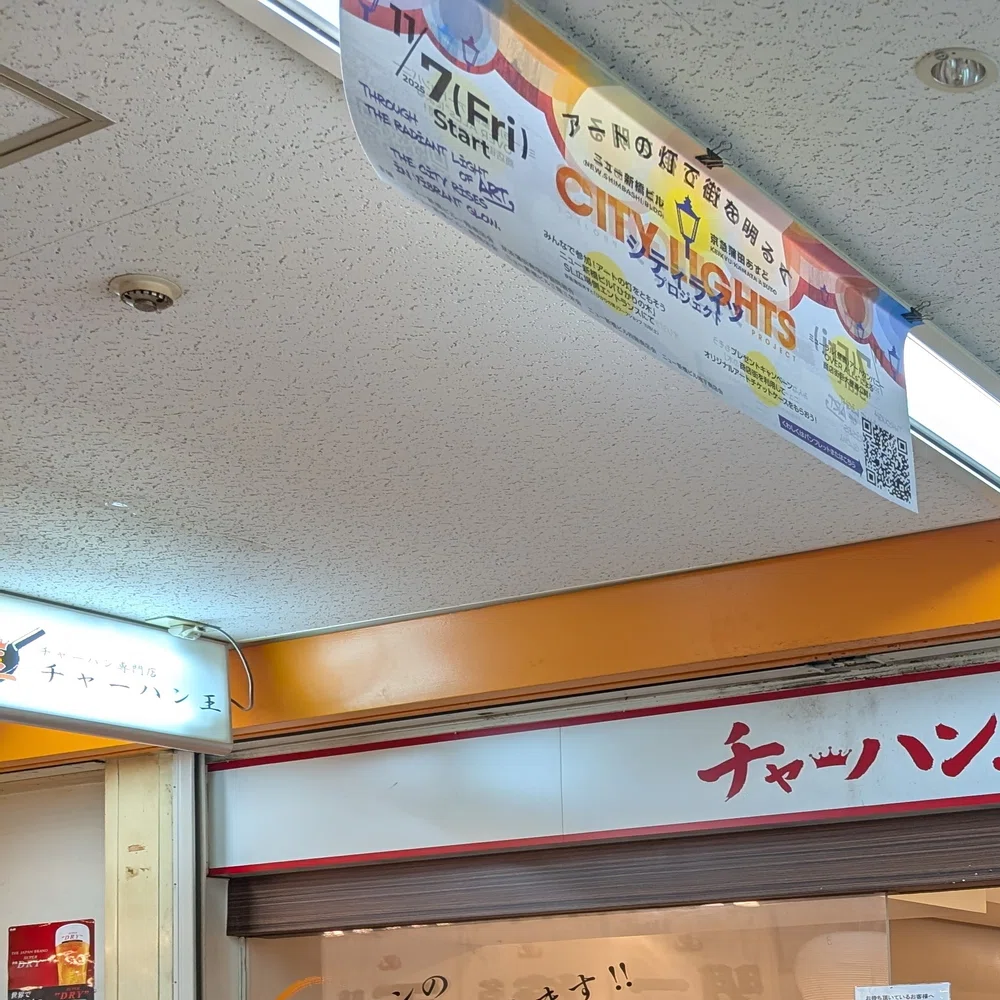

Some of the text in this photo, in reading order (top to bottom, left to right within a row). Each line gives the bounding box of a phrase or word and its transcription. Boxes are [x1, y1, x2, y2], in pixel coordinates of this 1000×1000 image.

[357, 80, 418, 125] THROUGH
[402, 74, 427, 95] 2025
[364, 103, 391, 126] THE
[433, 109, 491, 159] Start
[390, 147, 416, 169] THE
[459, 171, 510, 204] OF ART
[556, 166, 660, 260] CITY
[669, 233, 797, 350] LIGHTS
[626, 235, 744, 323] シティライツ
[654, 274, 722, 326] プロジェクト
[751, 329, 798, 362] PROJECT
[41, 646, 157, 678] チャーハン専門店
[41, 664, 221, 712] チャーハン王
